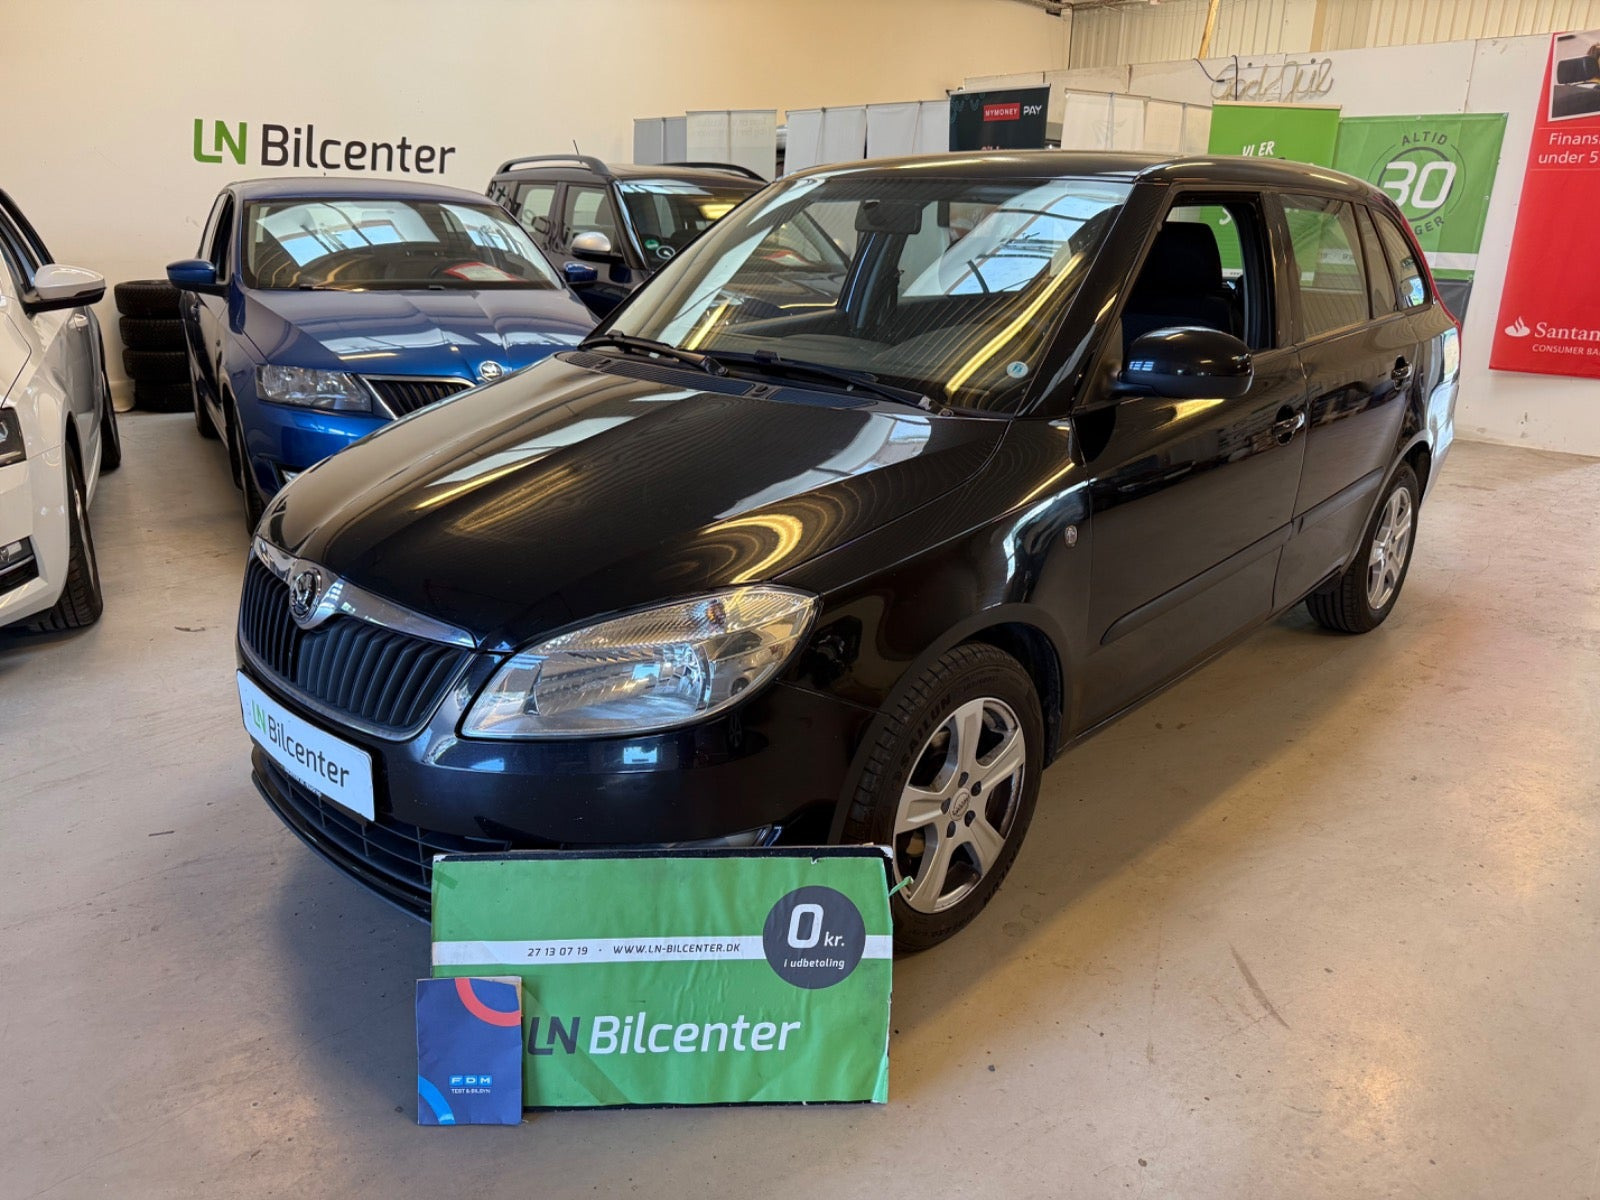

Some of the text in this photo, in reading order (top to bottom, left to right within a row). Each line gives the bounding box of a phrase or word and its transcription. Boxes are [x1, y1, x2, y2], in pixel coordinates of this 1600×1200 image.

[985, 105, 1042, 117] MYMONEY PAY
[193, 118, 456, 174] LN Bilcenter
[1402, 131, 1448, 146] ALTID
[1549, 132, 1600, 146] Finans
[1242, 141, 1275, 156] VI ER
[1538, 151, 1585, 164] under
[1383, 161, 1457, 209] 30
[1414, 216, 1445, 236] GER
[1532, 344, 1600, 356] CONSUMER BA
[251, 699, 267, 735] LN
[267, 714, 350, 788] Bilcenter
[787, 903, 845, 949] 0 kr.
[527, 942, 741, 957] 27 13 07 19 WWW.LN-BILCENTER.DK
[790, 957, 845, 970] udbetaling
[527, 1011, 802, 1056] LN Bilcenter
[450, 1076, 491, 1085] FDM
